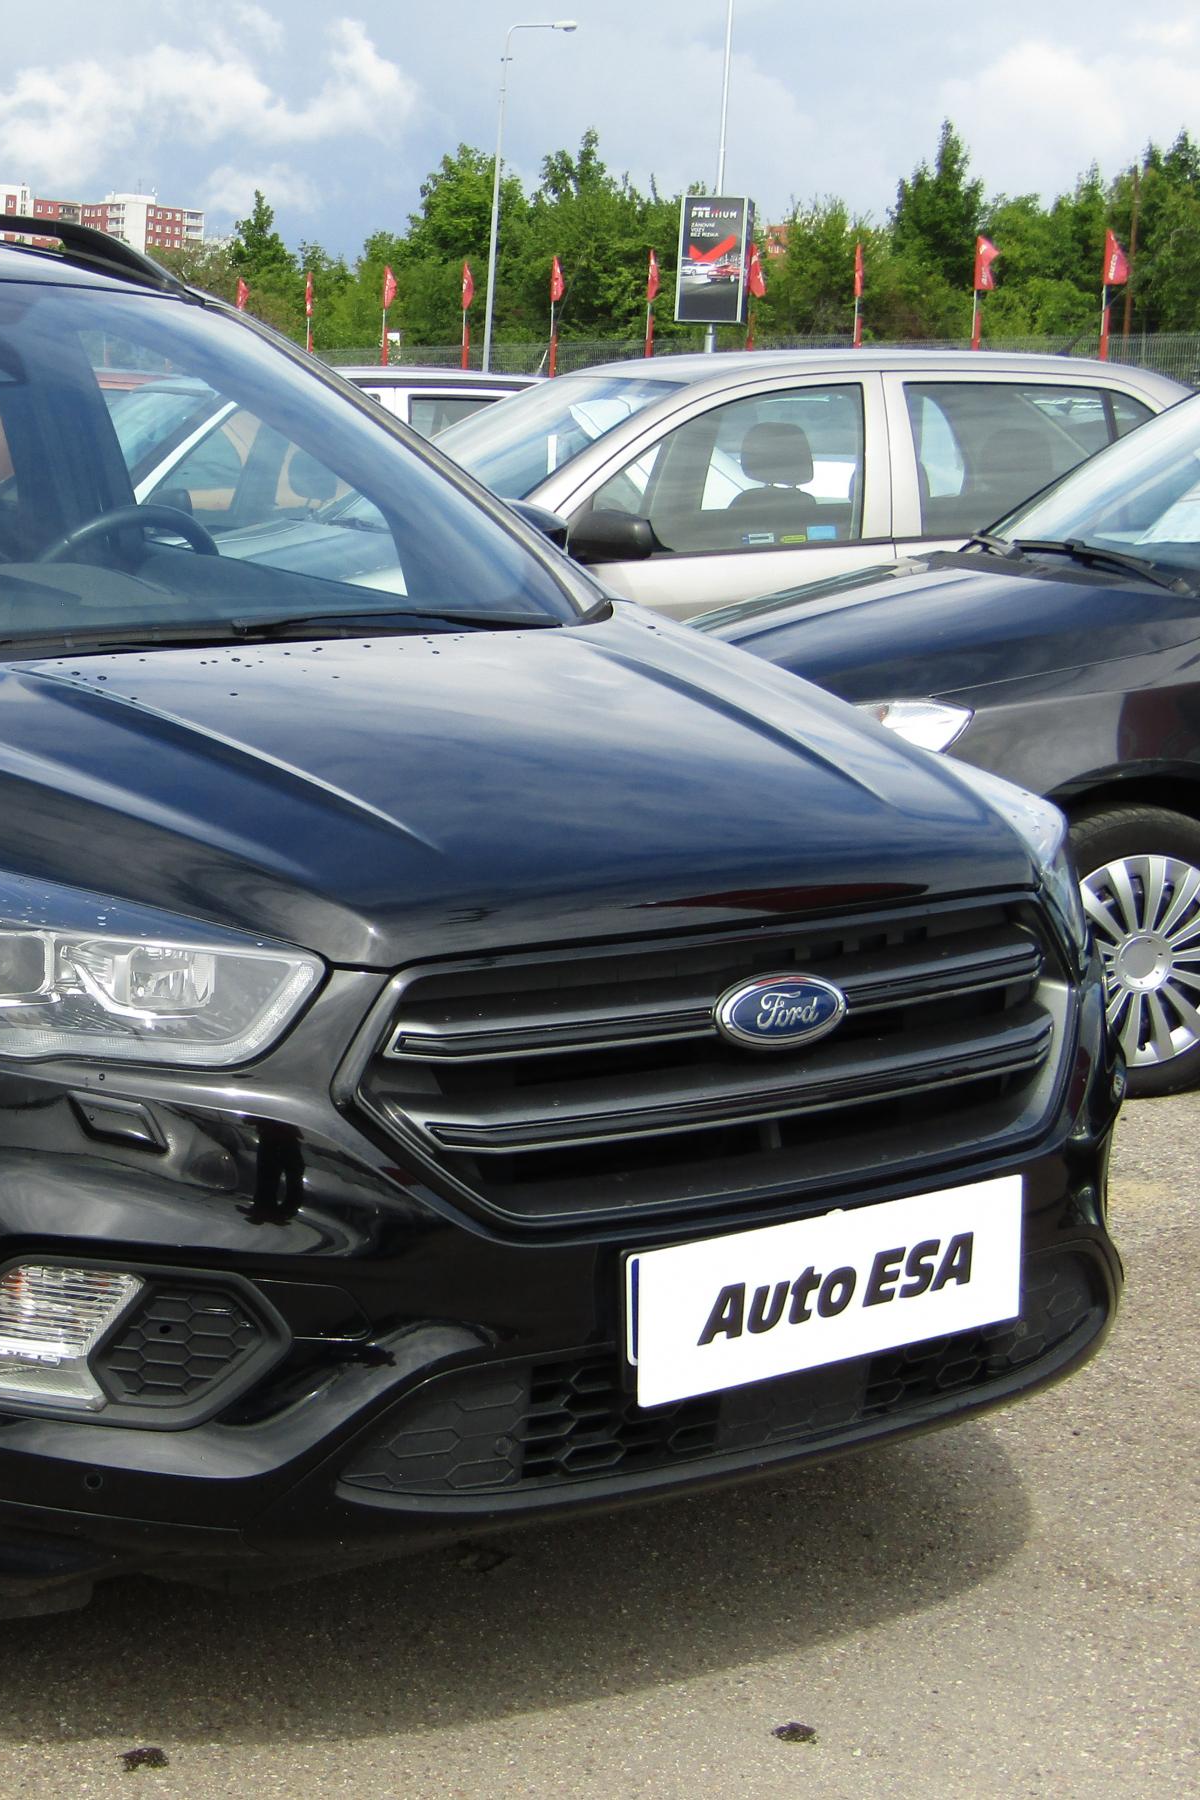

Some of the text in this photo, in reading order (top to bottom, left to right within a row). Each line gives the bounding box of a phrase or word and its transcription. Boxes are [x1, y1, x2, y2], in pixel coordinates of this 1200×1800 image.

[757, 991, 819, 1029] Ford
[697, 1231, 974, 1346] Auto ESA
